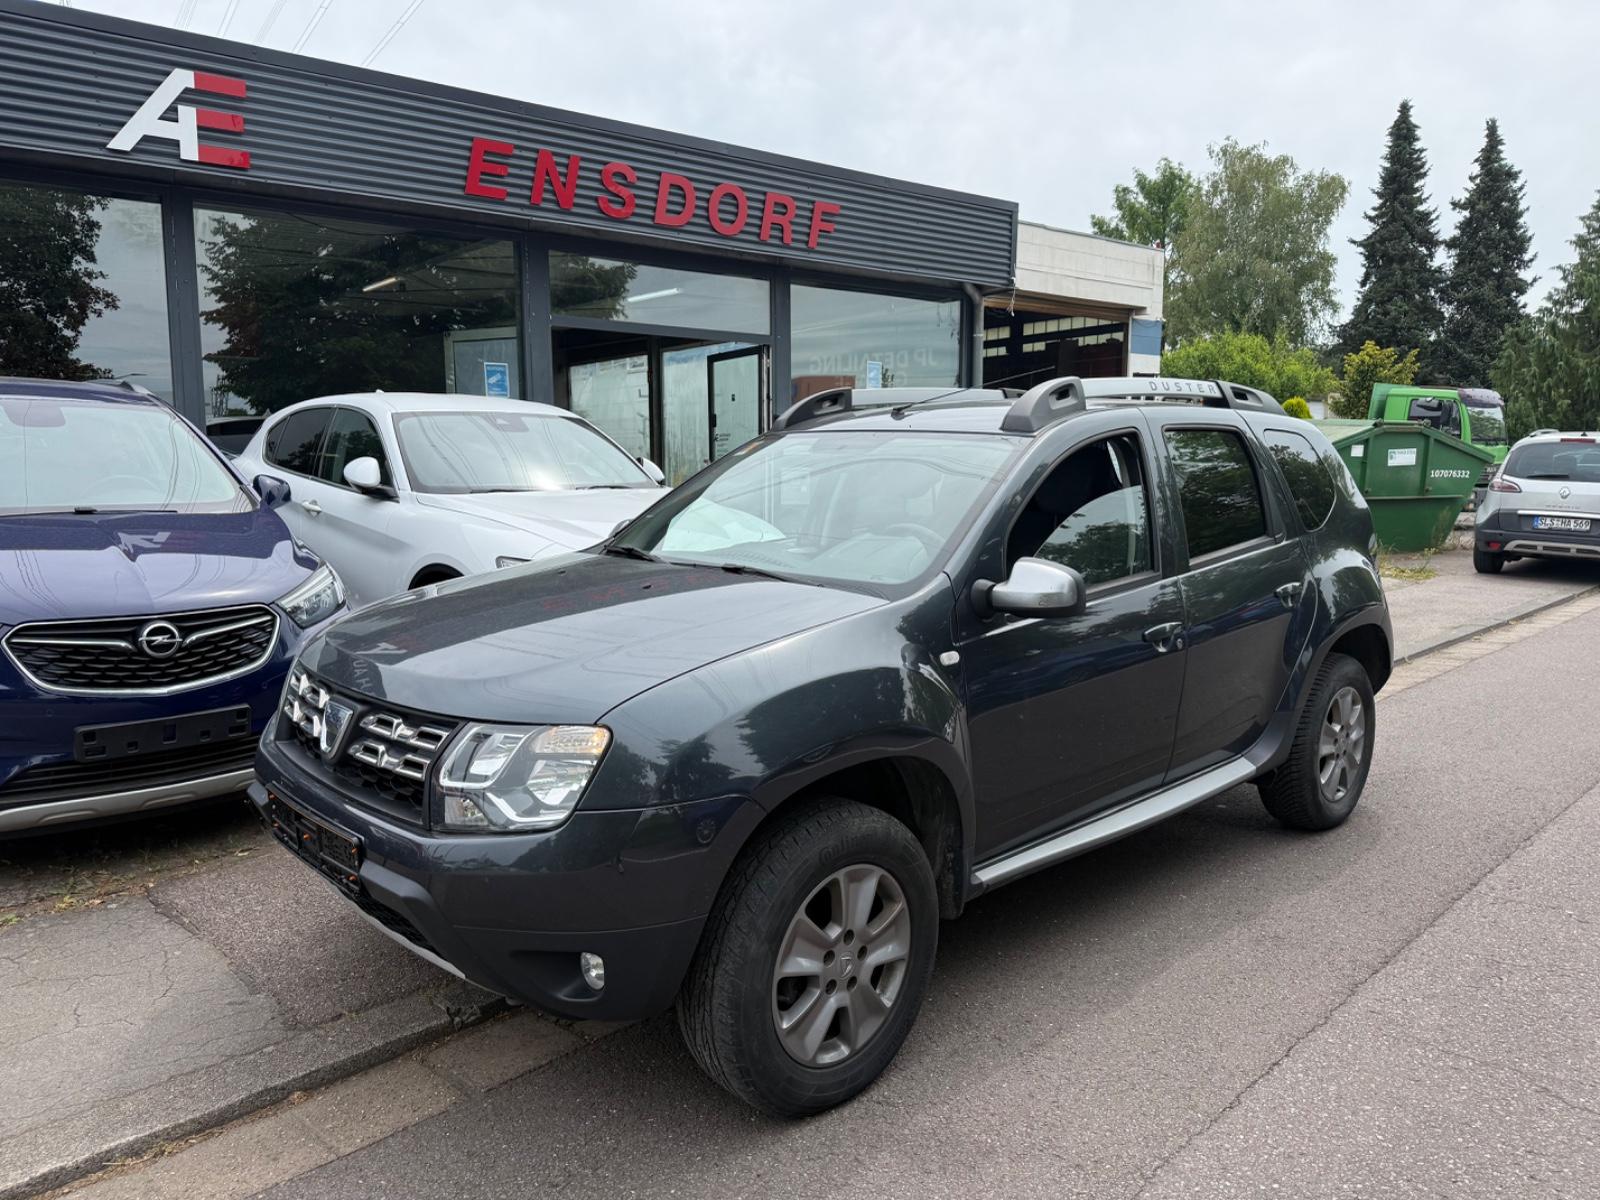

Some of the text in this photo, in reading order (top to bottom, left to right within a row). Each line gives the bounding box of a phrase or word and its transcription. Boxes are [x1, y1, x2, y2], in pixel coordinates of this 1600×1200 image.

[465, 138, 840, 248] ENSDORF
[1148, 381, 1217, 394] DUSTER
[1430, 469, 1470, 478] 107076332
